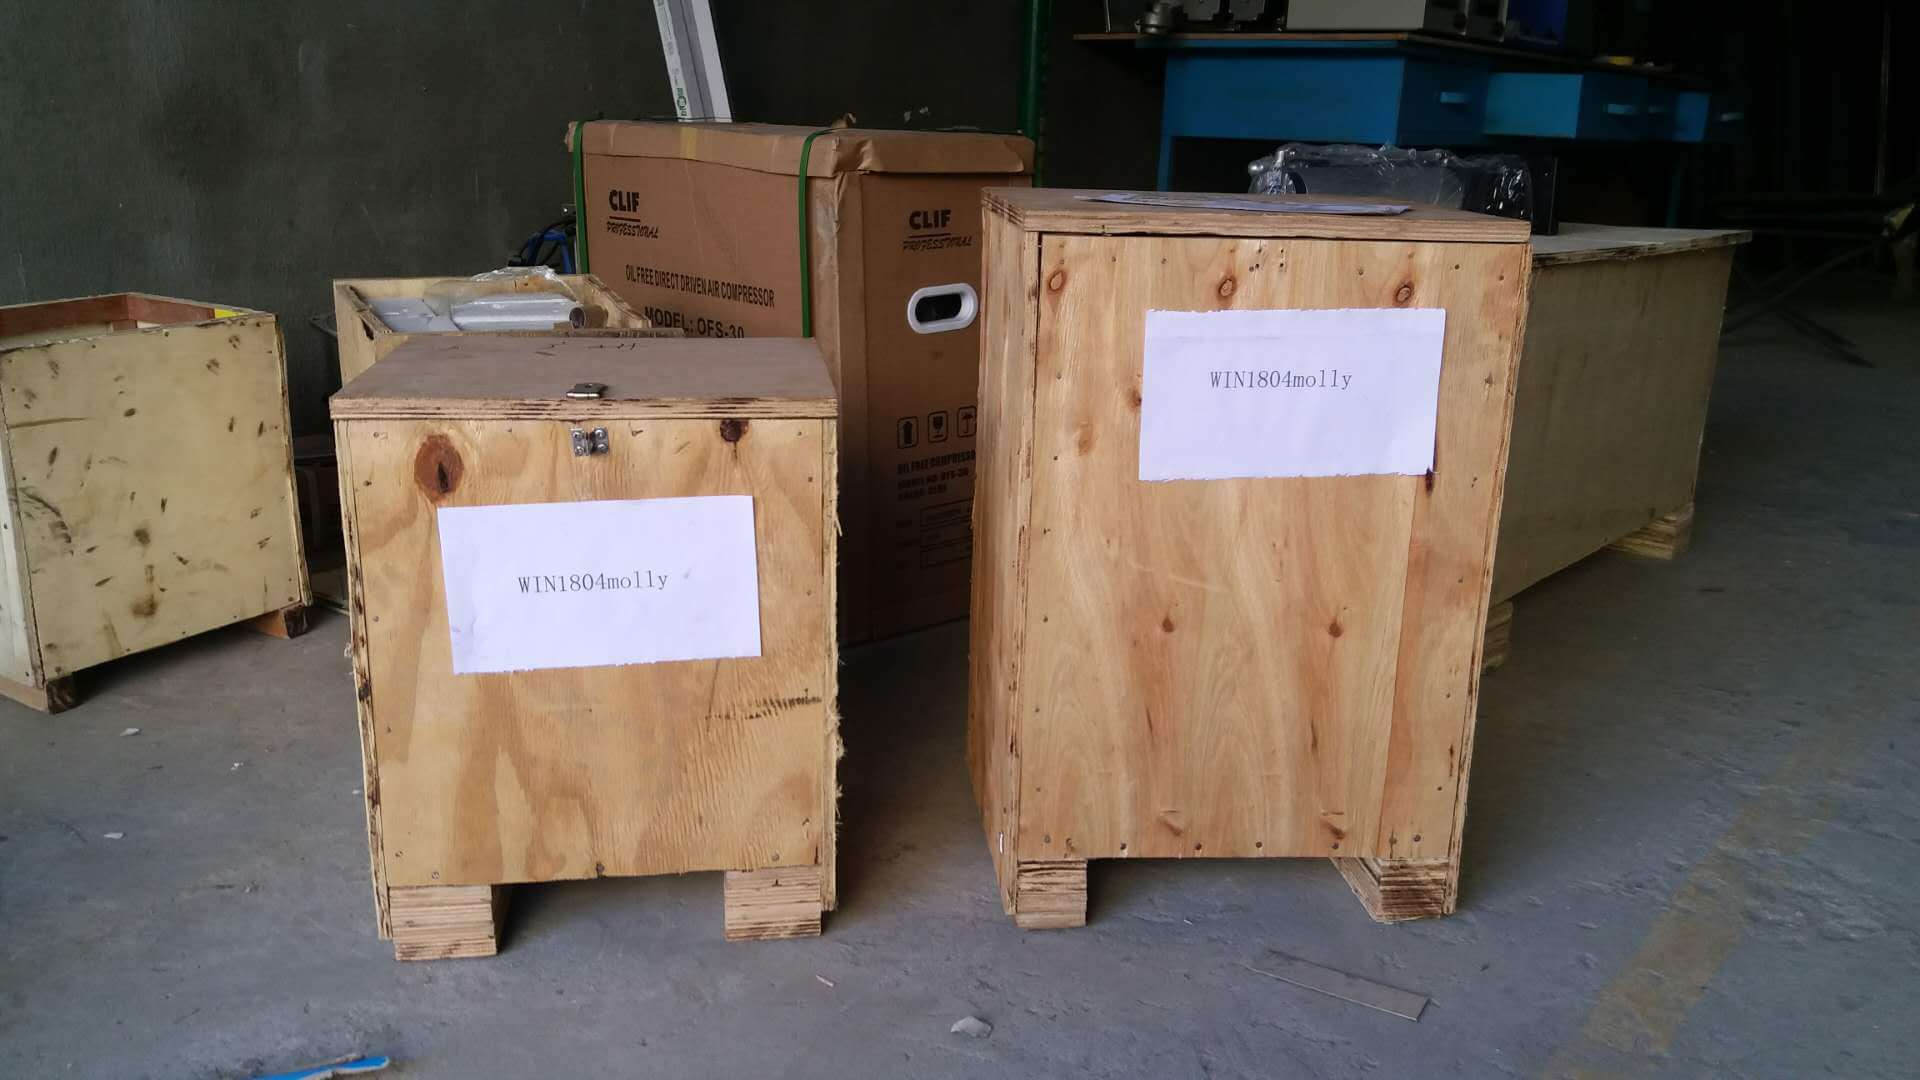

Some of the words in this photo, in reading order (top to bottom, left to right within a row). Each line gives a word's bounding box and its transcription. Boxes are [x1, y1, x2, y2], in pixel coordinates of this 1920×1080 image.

[608, 189, 640, 213] CLIF
[908, 208, 952, 230] CLIF
[625, 264, 636, 283] OIL
[636, 266, 654, 286] FREE
[654, 270, 679, 290] DIRECT
[680, 274, 707, 297] DRIVEN
[707, 279, 721, 299] AIR
[721, 281, 775, 309] COMPRESSOR
[1210, 369, 1353, 391] WIN1804molly
[518, 570, 669, 594] WIN1804molly
